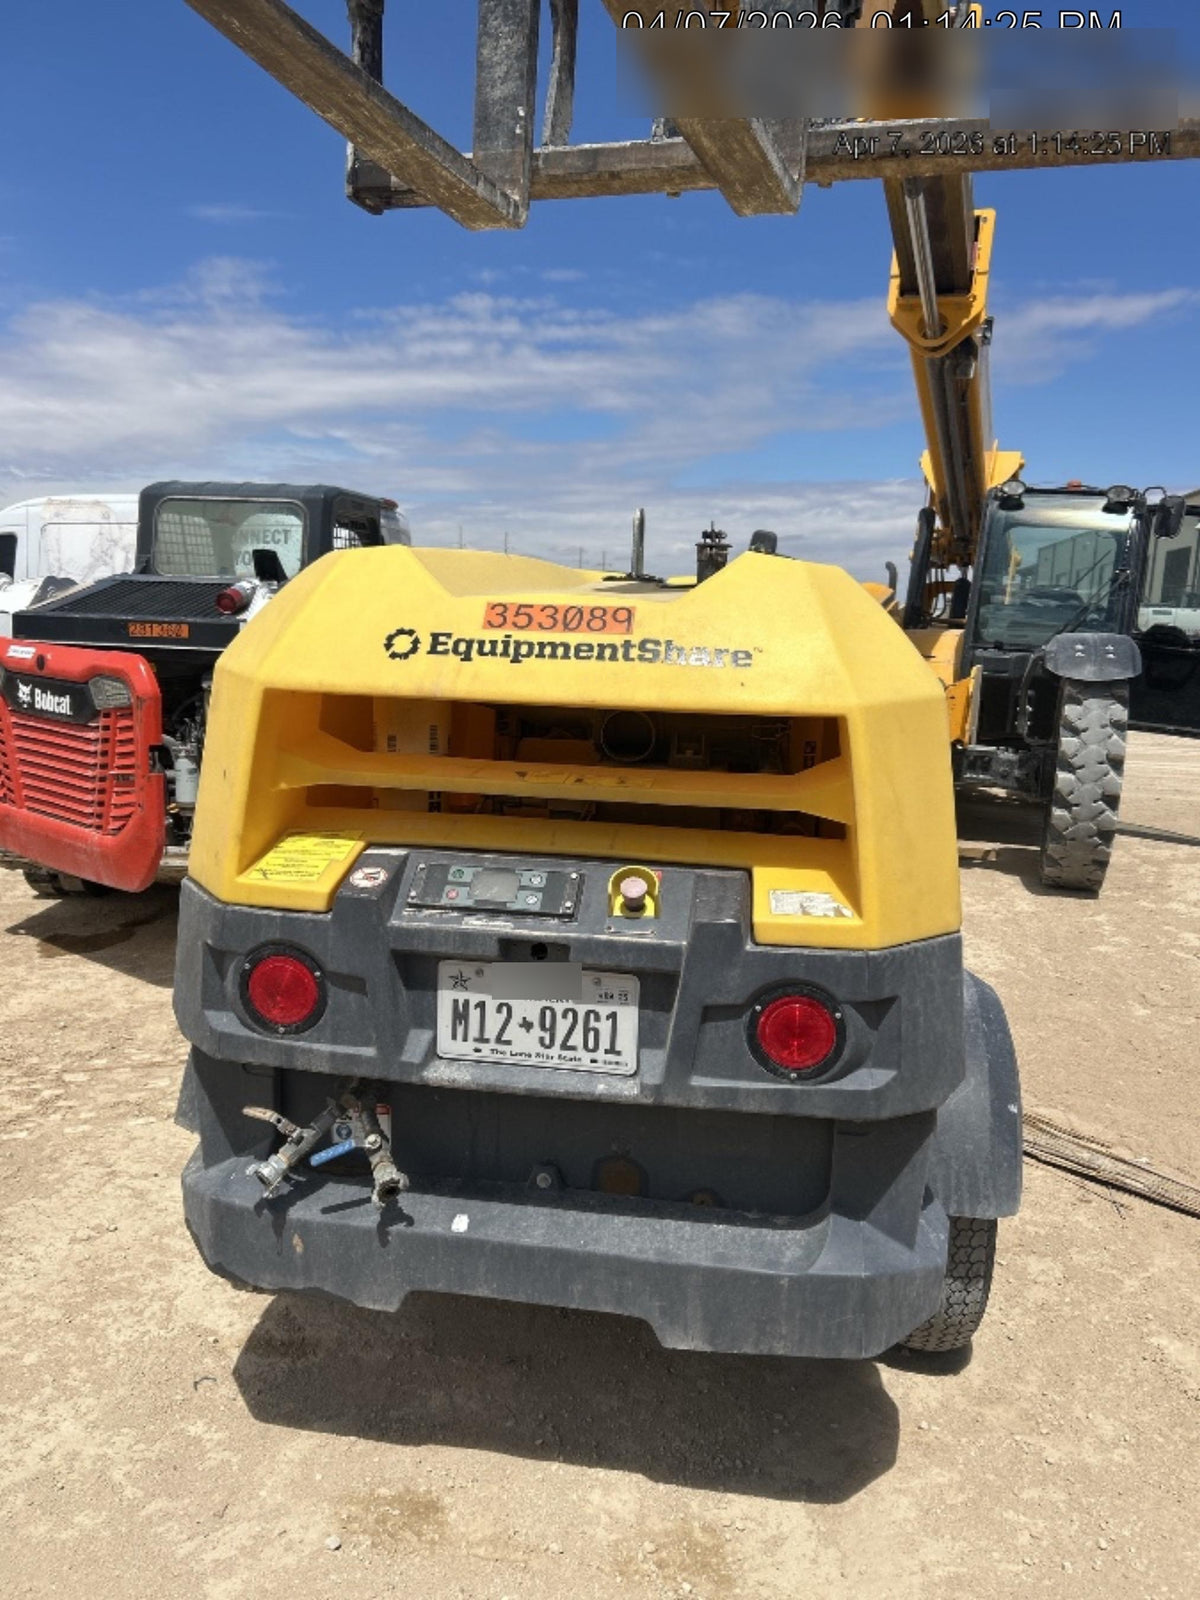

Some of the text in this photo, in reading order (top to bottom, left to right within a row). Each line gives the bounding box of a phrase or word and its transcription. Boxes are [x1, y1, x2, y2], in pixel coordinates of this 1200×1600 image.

[486, 603, 634, 633] 353089
[427, 633, 754, 669] EquipmentShare
[34, 688, 73, 716] Bobcat
